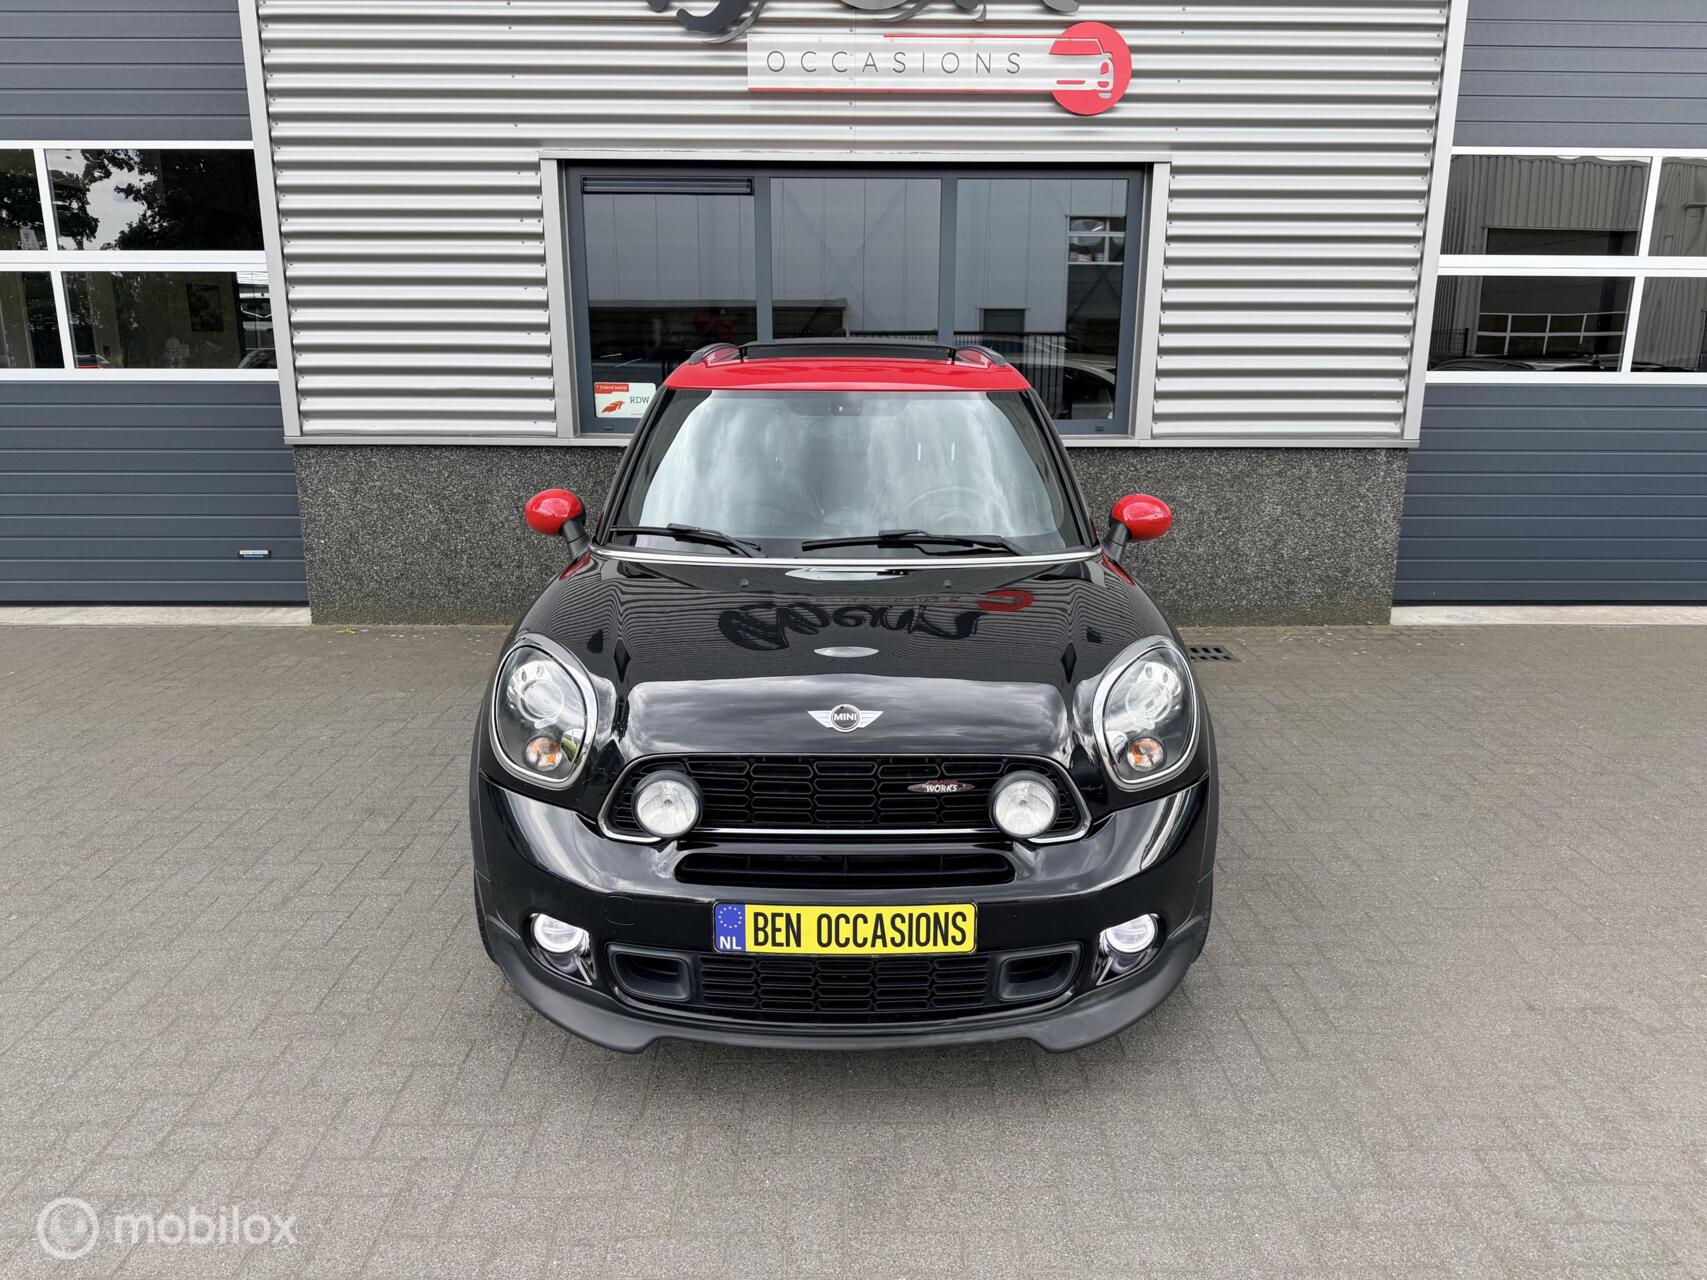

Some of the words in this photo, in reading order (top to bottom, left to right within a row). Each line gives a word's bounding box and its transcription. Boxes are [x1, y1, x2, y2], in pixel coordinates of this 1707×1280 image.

[766, 50, 1023, 75] OCCASIONS
[629, 396, 650, 404] RDW
[833, 713, 857, 721] MINI
[926, 784, 958, 793] WORKS
[753, 911, 801, 948] BEN
[816, 911, 967, 948] OCCASIONS
[719, 935, 742, 950] NL
